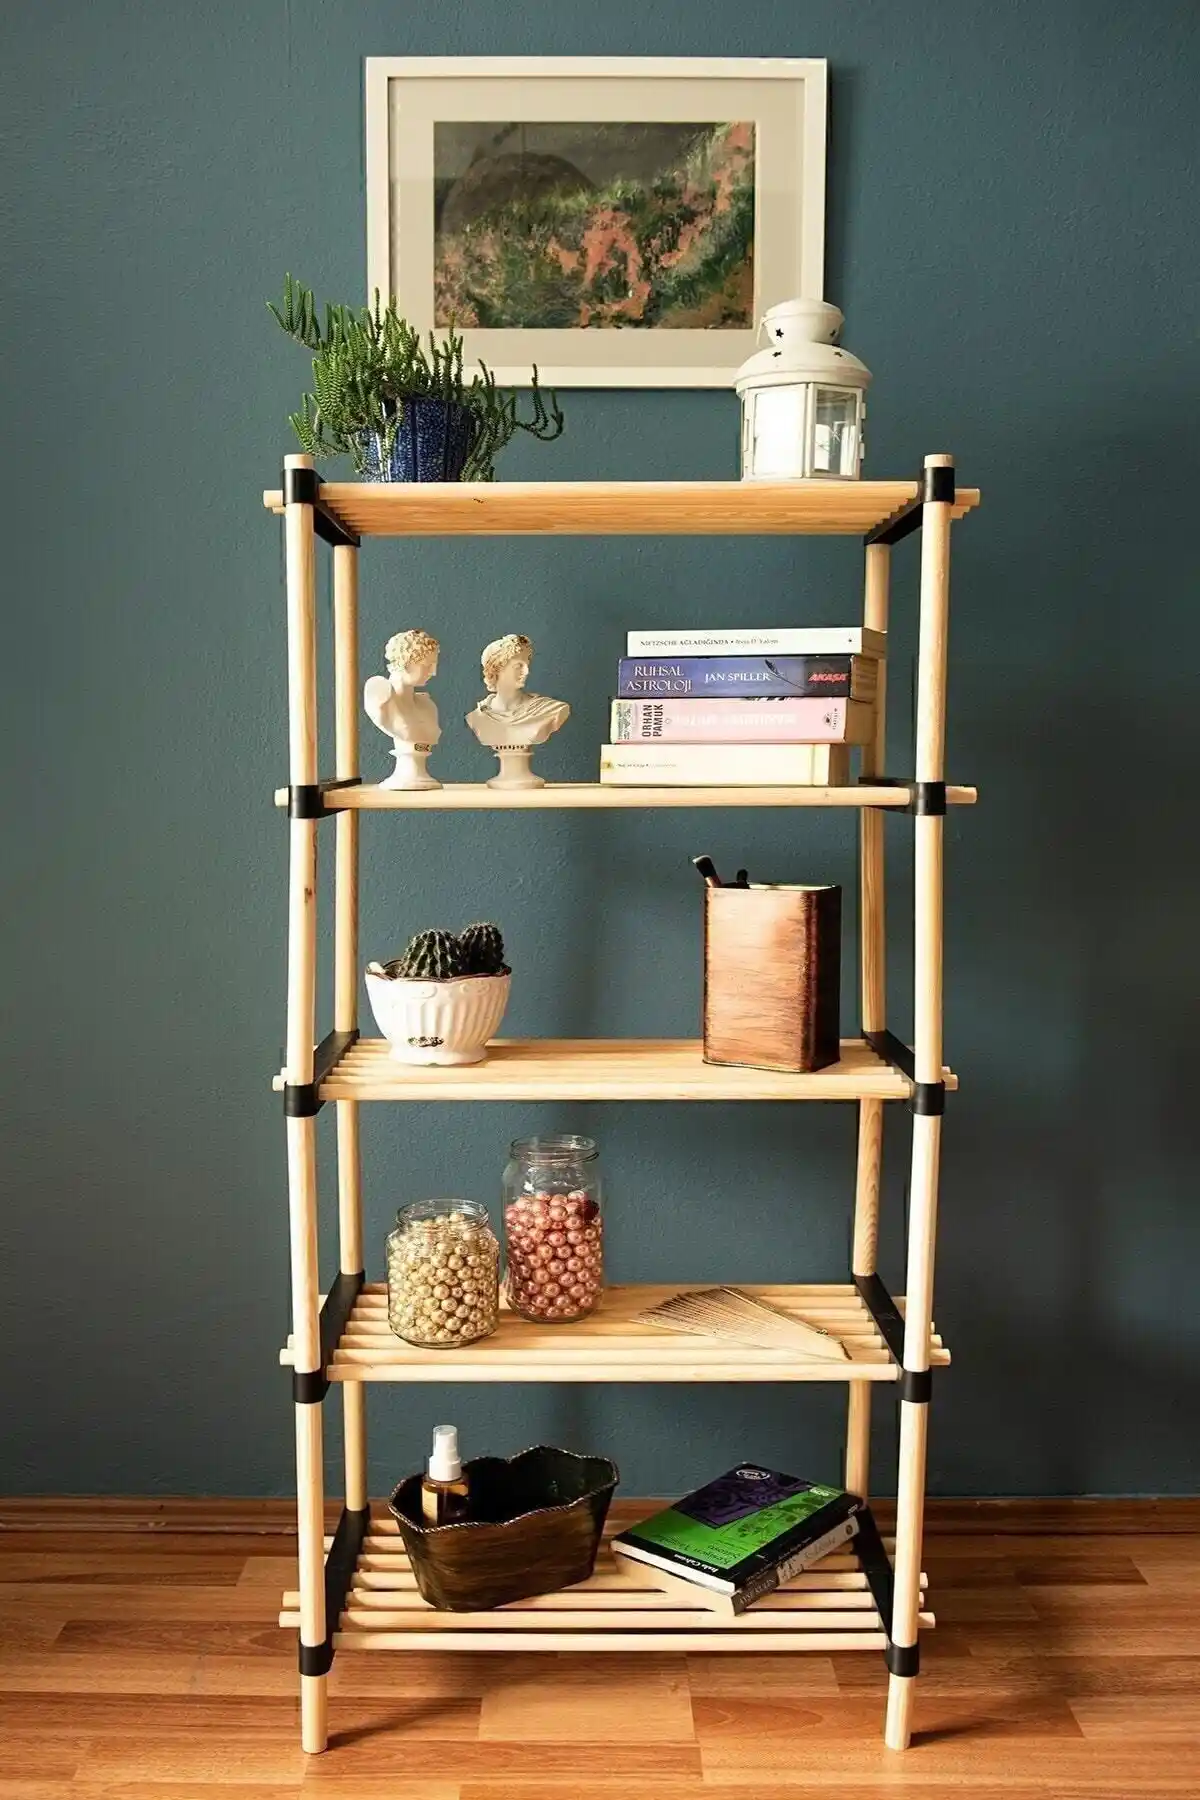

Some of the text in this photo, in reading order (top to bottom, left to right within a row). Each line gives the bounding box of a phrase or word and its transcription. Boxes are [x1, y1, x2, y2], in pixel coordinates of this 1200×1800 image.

[634, 665, 685, 677] RUHSAL
[704, 672, 773, 685] JAN SPILLER
[641, 704, 652, 737] ORHAN
[652, 704, 664, 737] PAMUK
